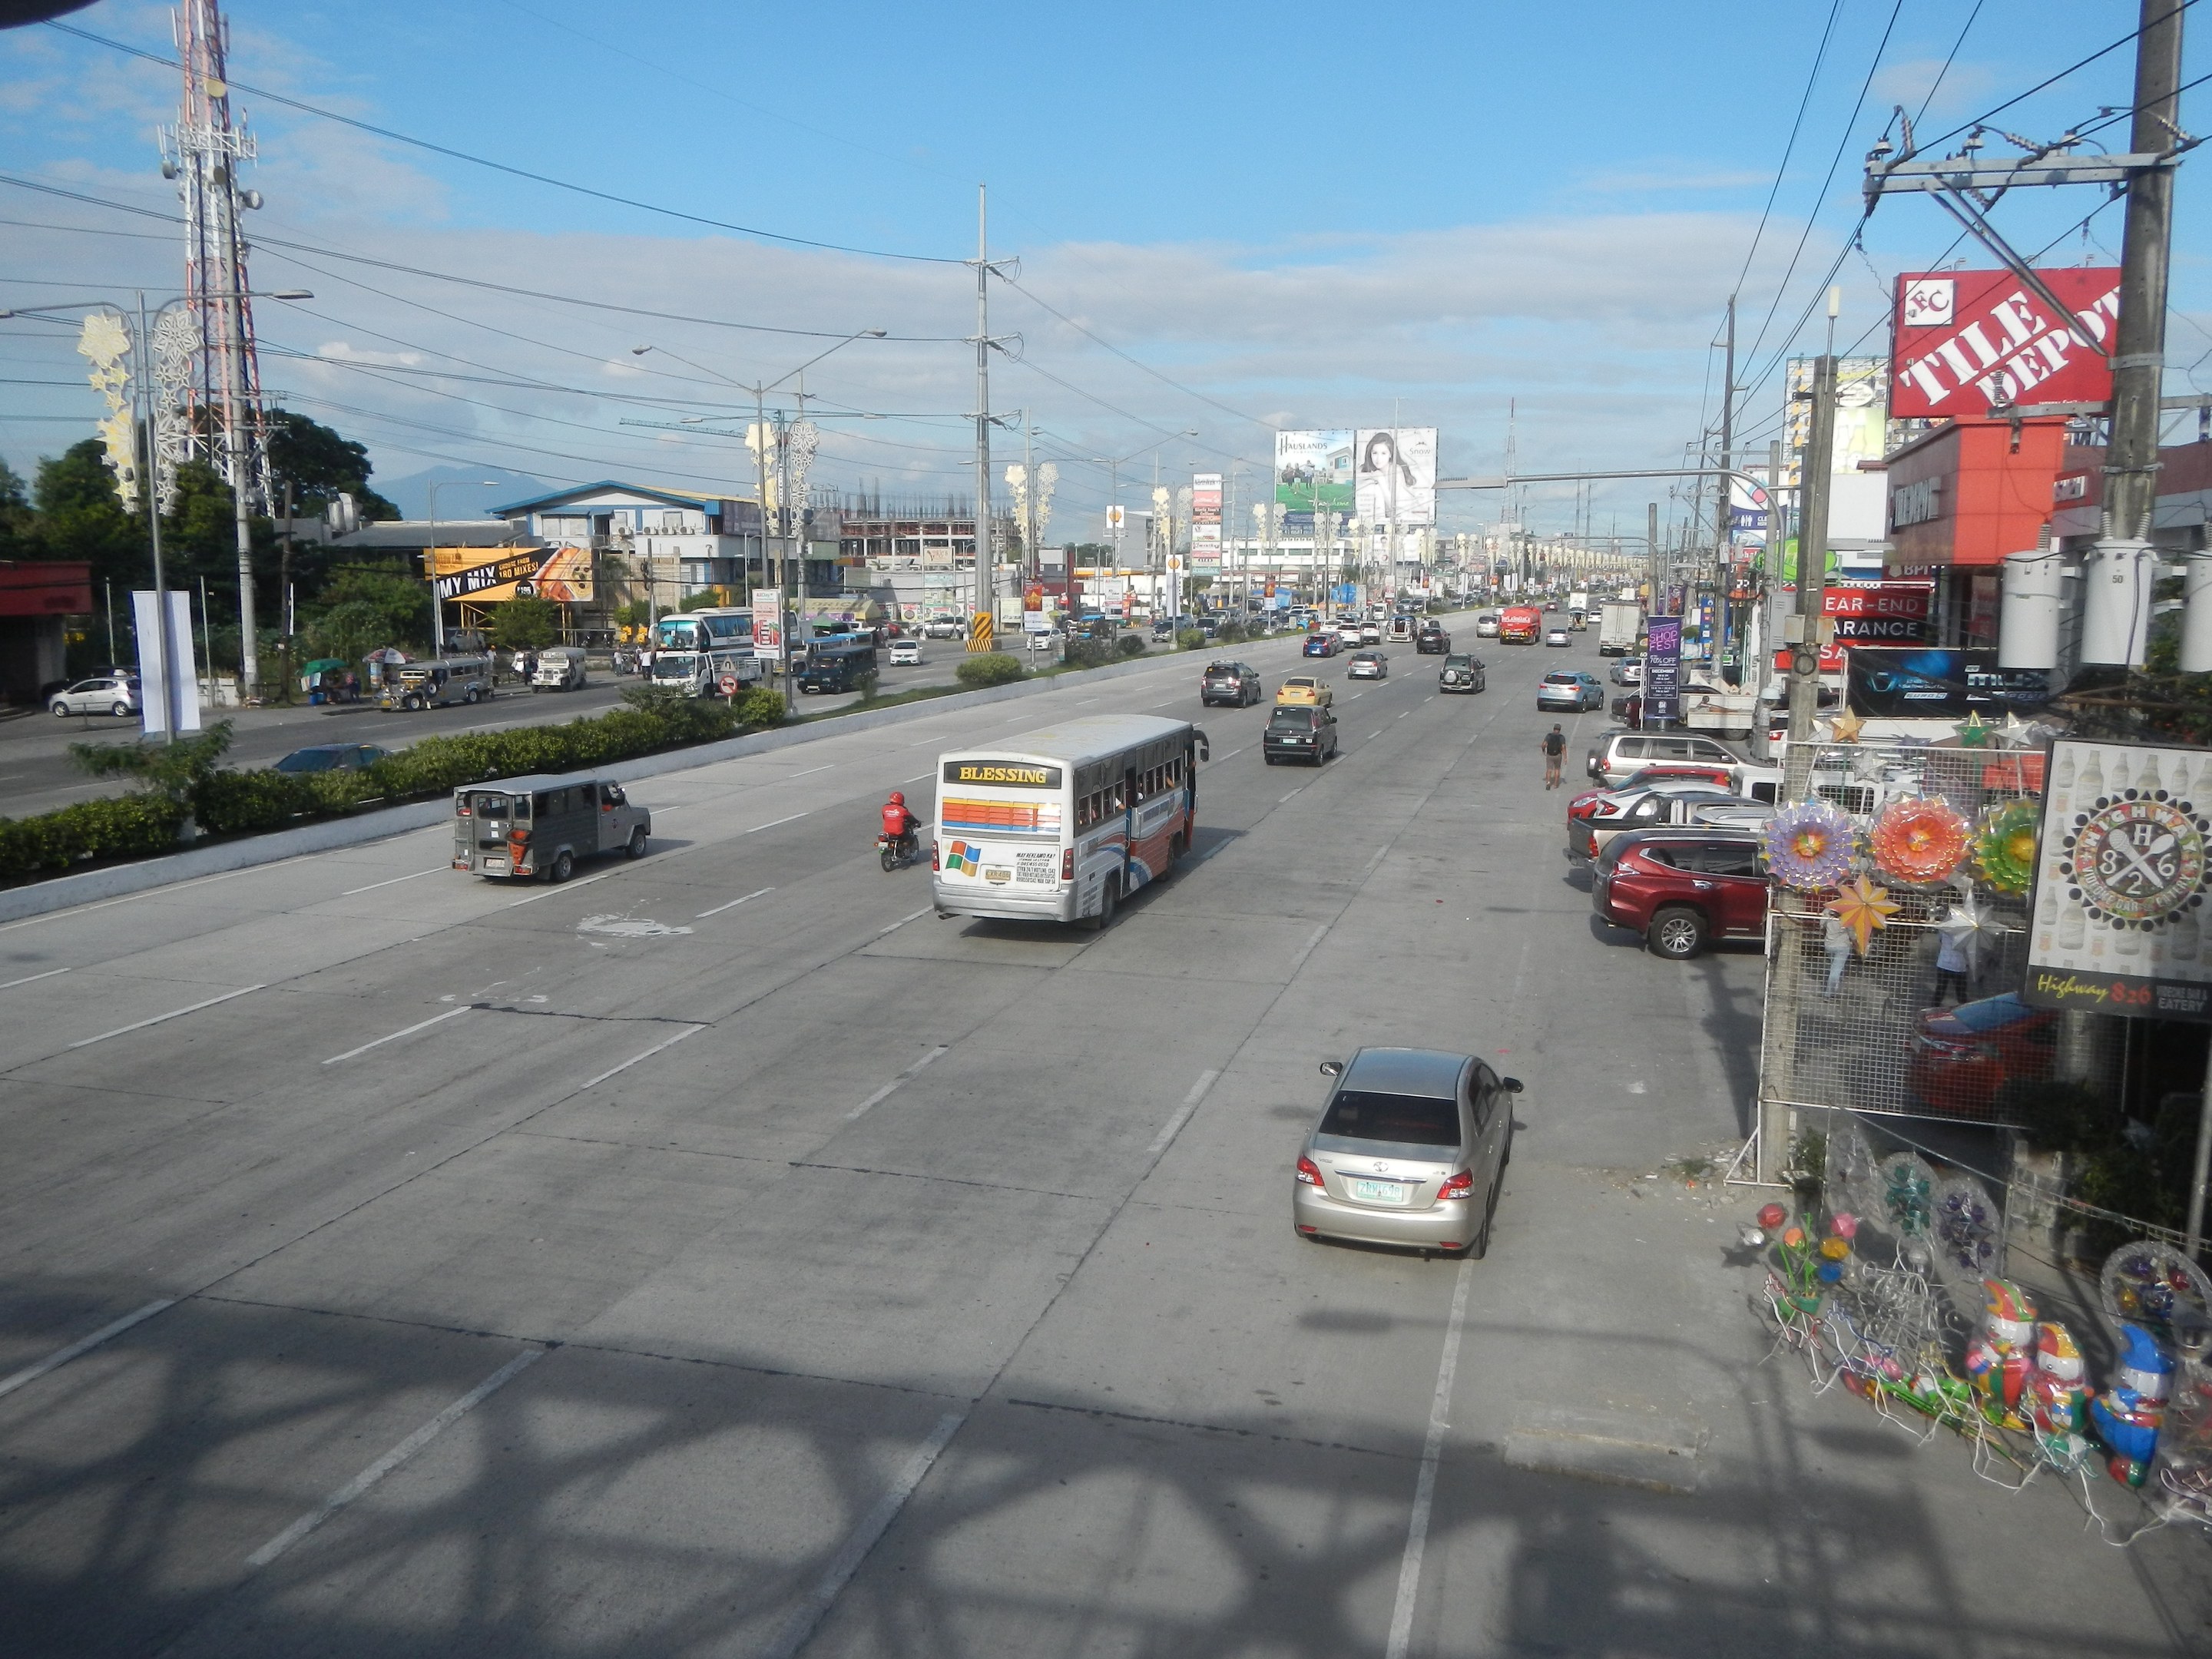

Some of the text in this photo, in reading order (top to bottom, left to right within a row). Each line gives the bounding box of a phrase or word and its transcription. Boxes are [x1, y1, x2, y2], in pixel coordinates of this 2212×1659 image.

[1899, 290, 2047, 406] TILE
[1278, 435, 1328, 455] HAUSLANDS
[514, 561, 539, 576] MIXES!
[1904, 565, 1929, 575] BPI
[438, 565, 497, 598] MY MIX
[2112, 575, 2124, 584] 50
[1825, 597, 1919, 612] EAR-END
[1649, 630, 1677, 642] SHOP
[1833, 621, 1918, 636] ARANCE
[1649, 639, 1677, 651] FEST
[959, 767, 1047, 783] BLESSING
[2084, 806, 2197, 852] HIGHWAY
[2133, 823, 2152, 846] H
[2038, 974, 2108, 1003] Highway
[2158, 997, 2205, 1012] EATERY
[1383, 1186, 1400, 1195] 698
